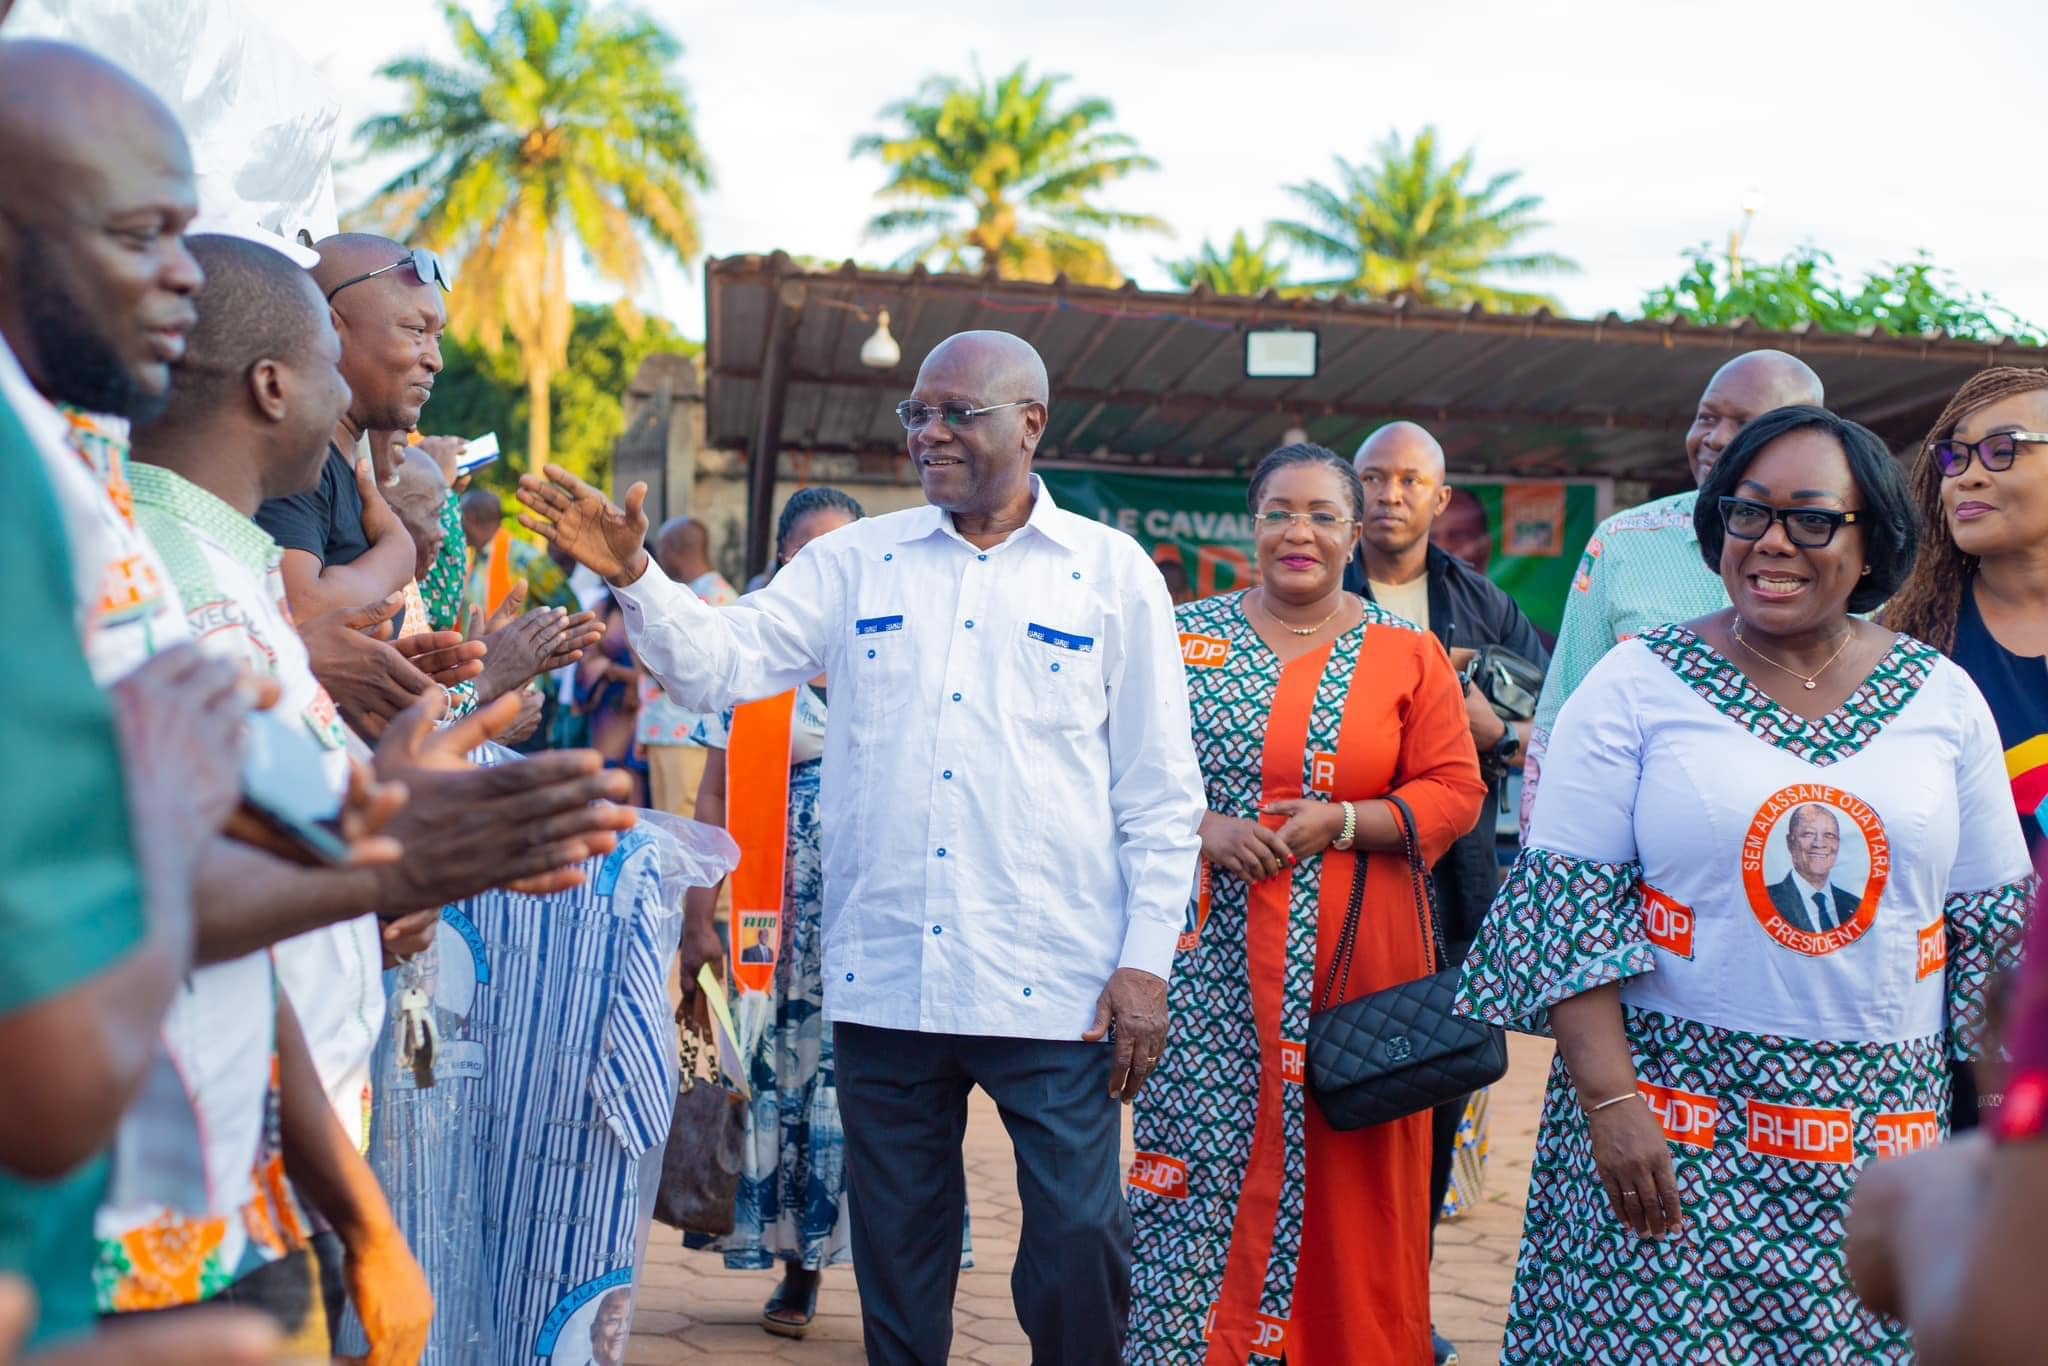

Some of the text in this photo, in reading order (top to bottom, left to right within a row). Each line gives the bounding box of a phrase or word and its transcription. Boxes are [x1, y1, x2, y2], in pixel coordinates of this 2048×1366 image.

[1744, 784, 1889, 879] SEM ALASSANE OUATTARA
[1764, 915, 1864, 953] PRESIDENT
[1752, 1112, 1849, 1153] RHDP
